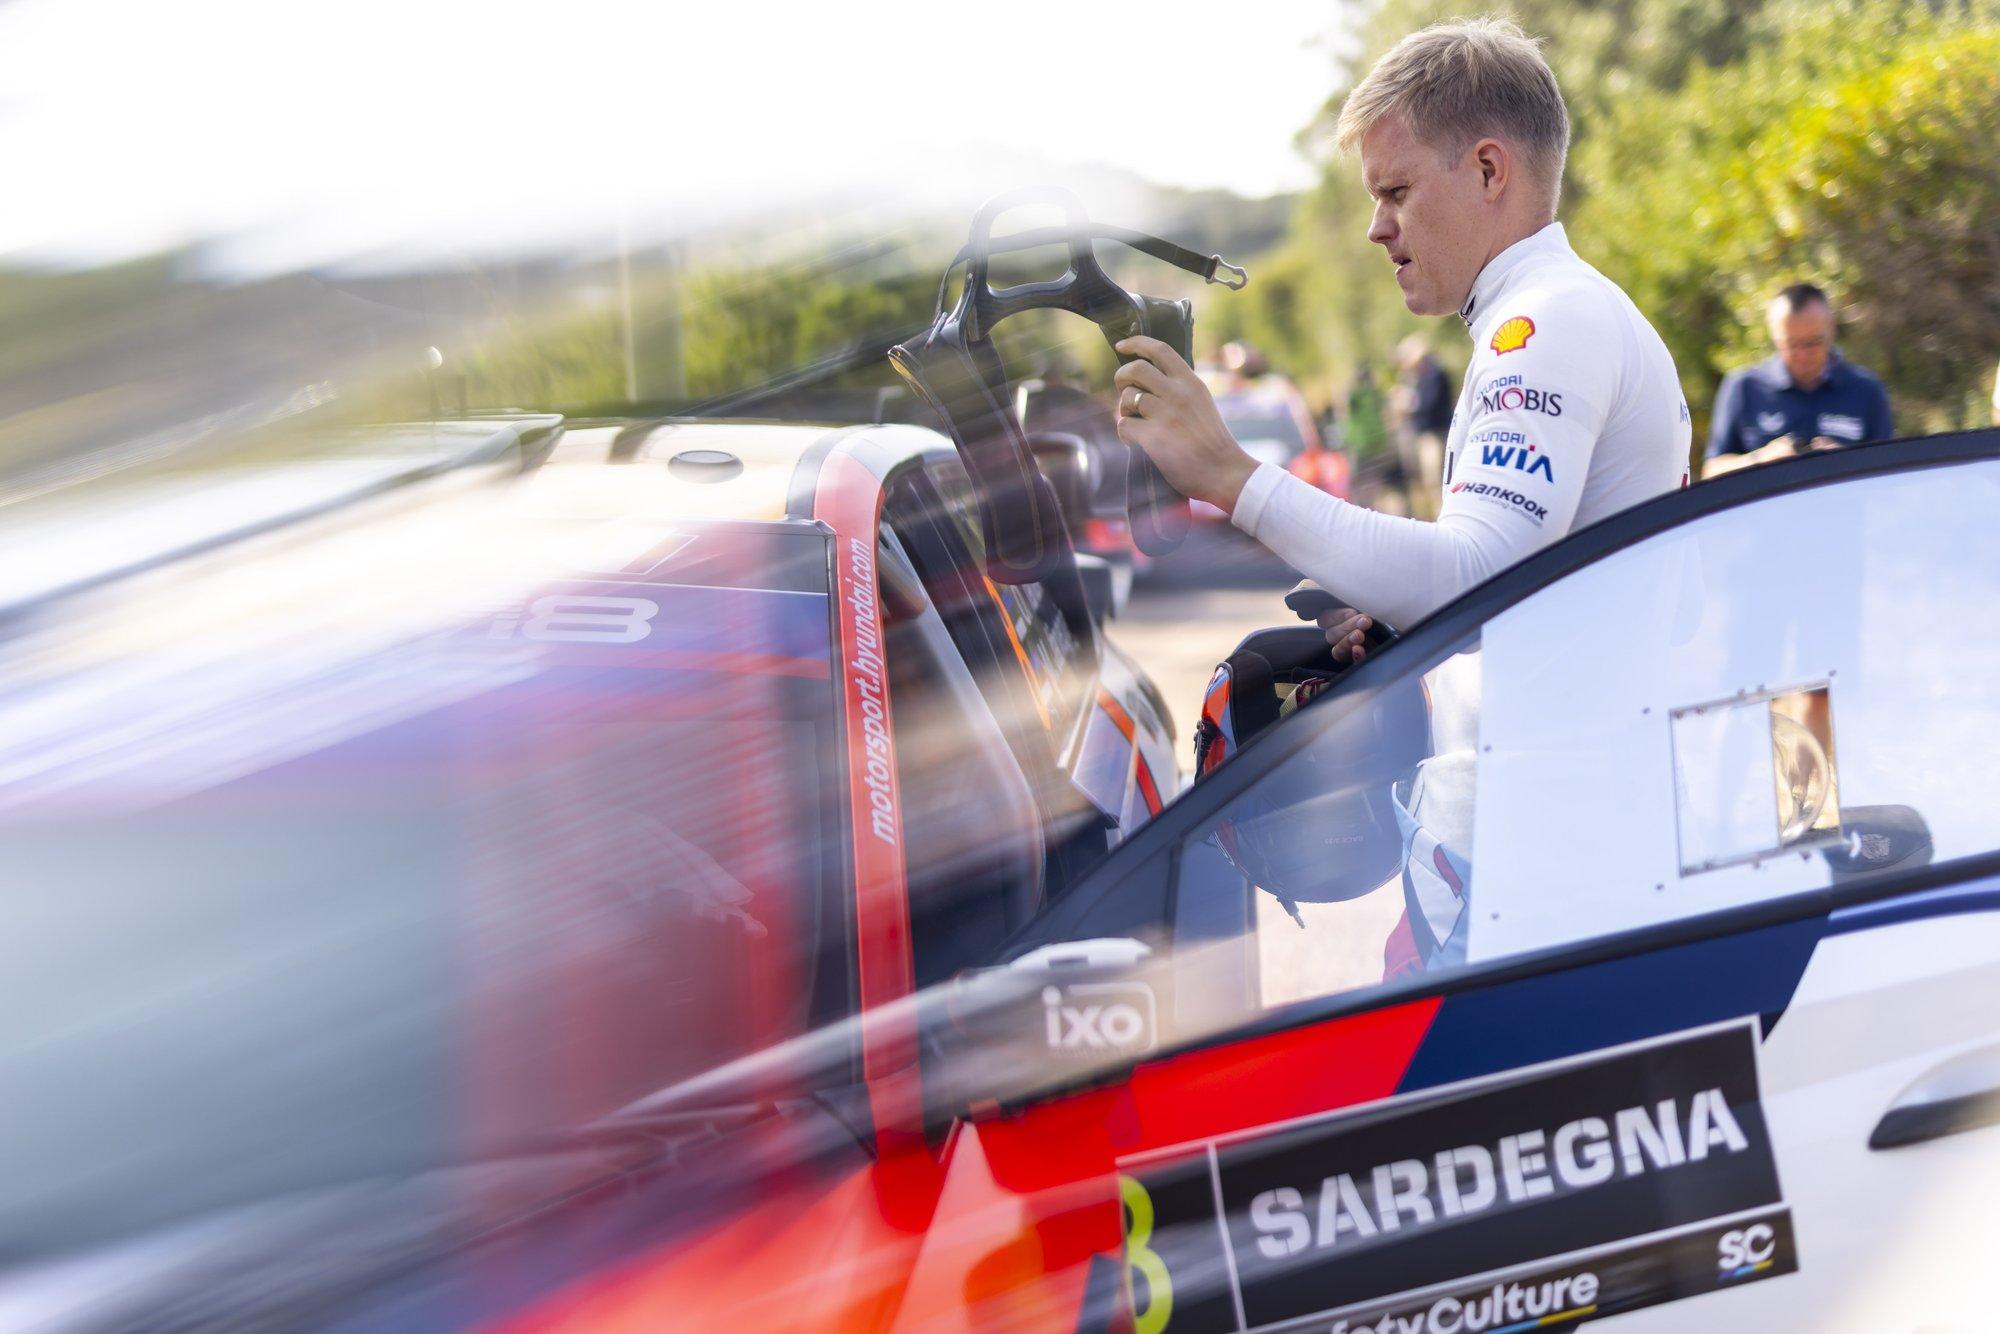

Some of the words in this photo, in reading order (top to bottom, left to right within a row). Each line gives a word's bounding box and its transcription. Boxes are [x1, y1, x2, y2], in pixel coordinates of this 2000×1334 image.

[1482, 387, 1562, 417] MOBIS
[1470, 431, 1526, 444] YUNDAI
[845, 537, 896, 845] motorsport.hyundai.com
[1250, 1087, 1749, 1260] SARDEGNA
[1717, 1222, 1776, 1272] SC
